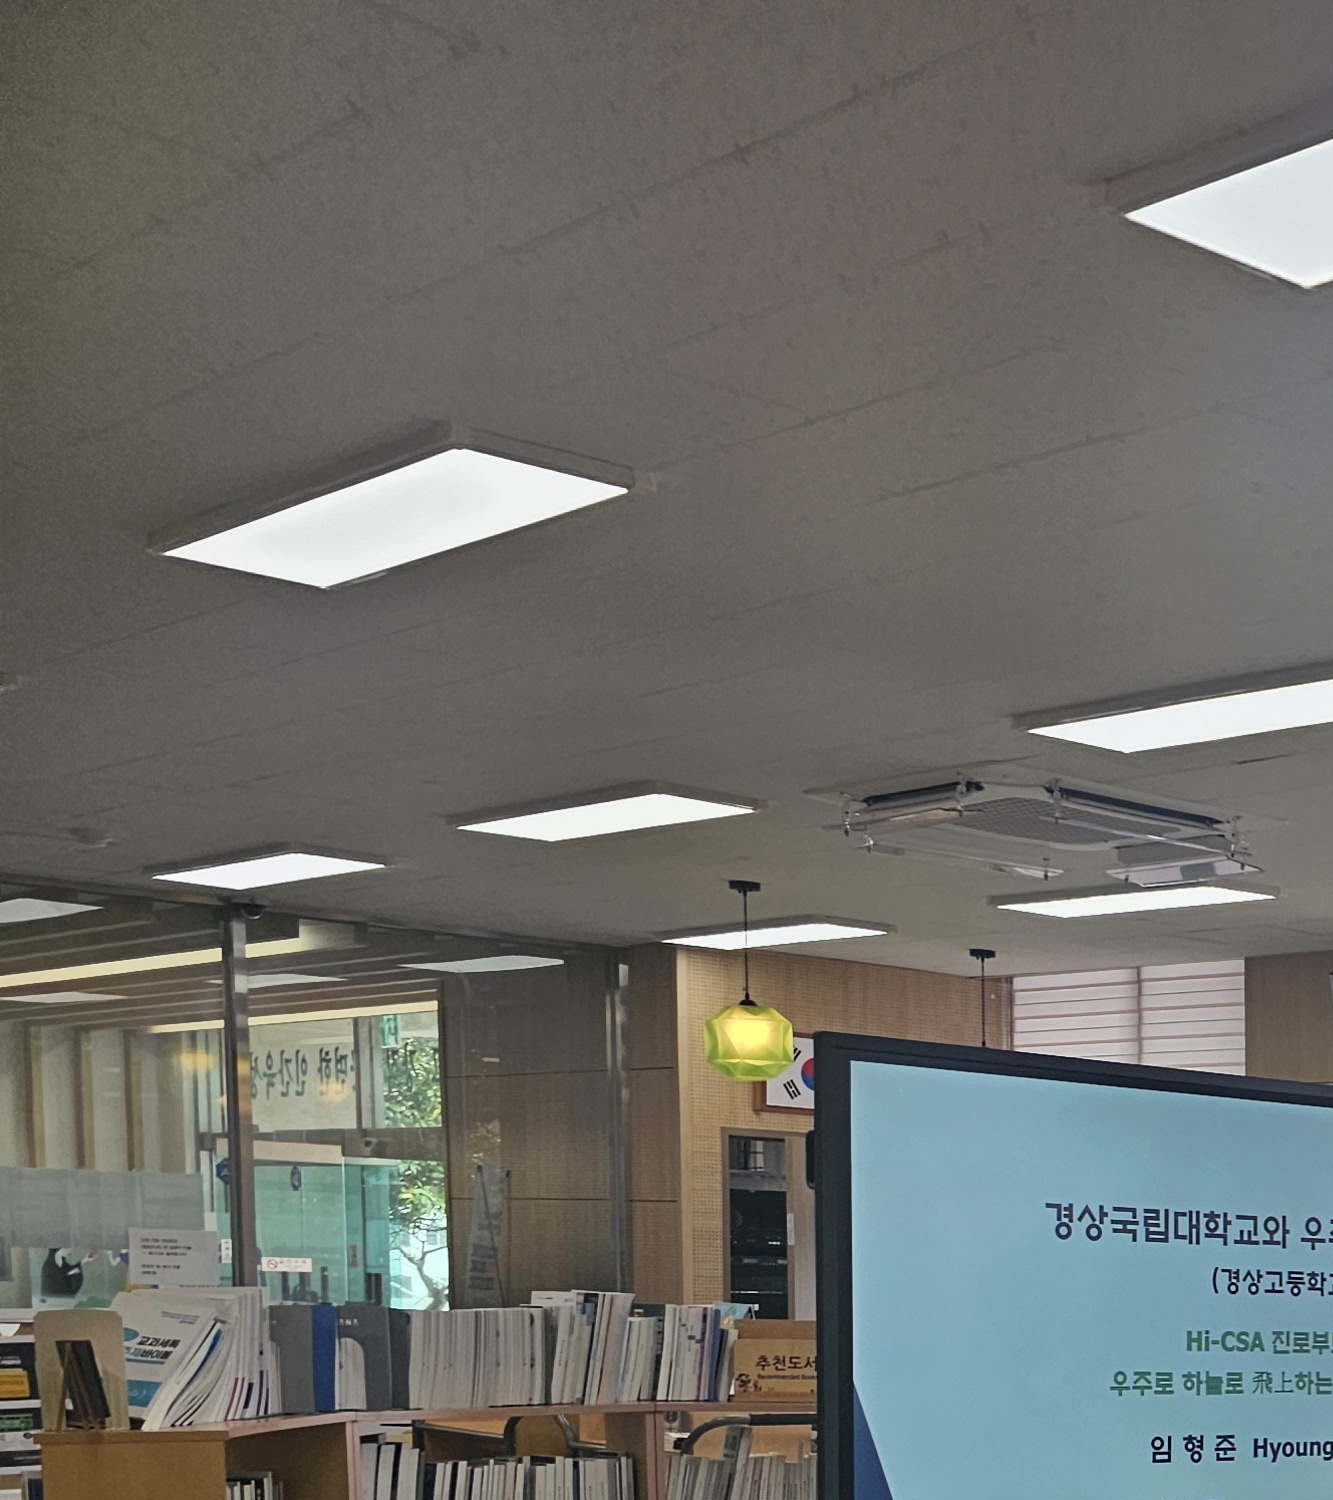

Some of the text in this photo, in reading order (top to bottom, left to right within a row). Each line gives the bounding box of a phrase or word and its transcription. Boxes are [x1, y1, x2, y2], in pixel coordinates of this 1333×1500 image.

[1045, 1202, 1290, 1249] 경상국립대학교와
[1186, 1330, 1265, 1352] Hi-CSA
[1110, 1370, 1174, 1396] 우주로
[1182, 1370, 1244, 1396] 하늘로
[1151, 1436, 1172, 1463] 임
[1183, 1435, 1204, 1463] 형
[1214, 1435, 1236, 1461] 준
